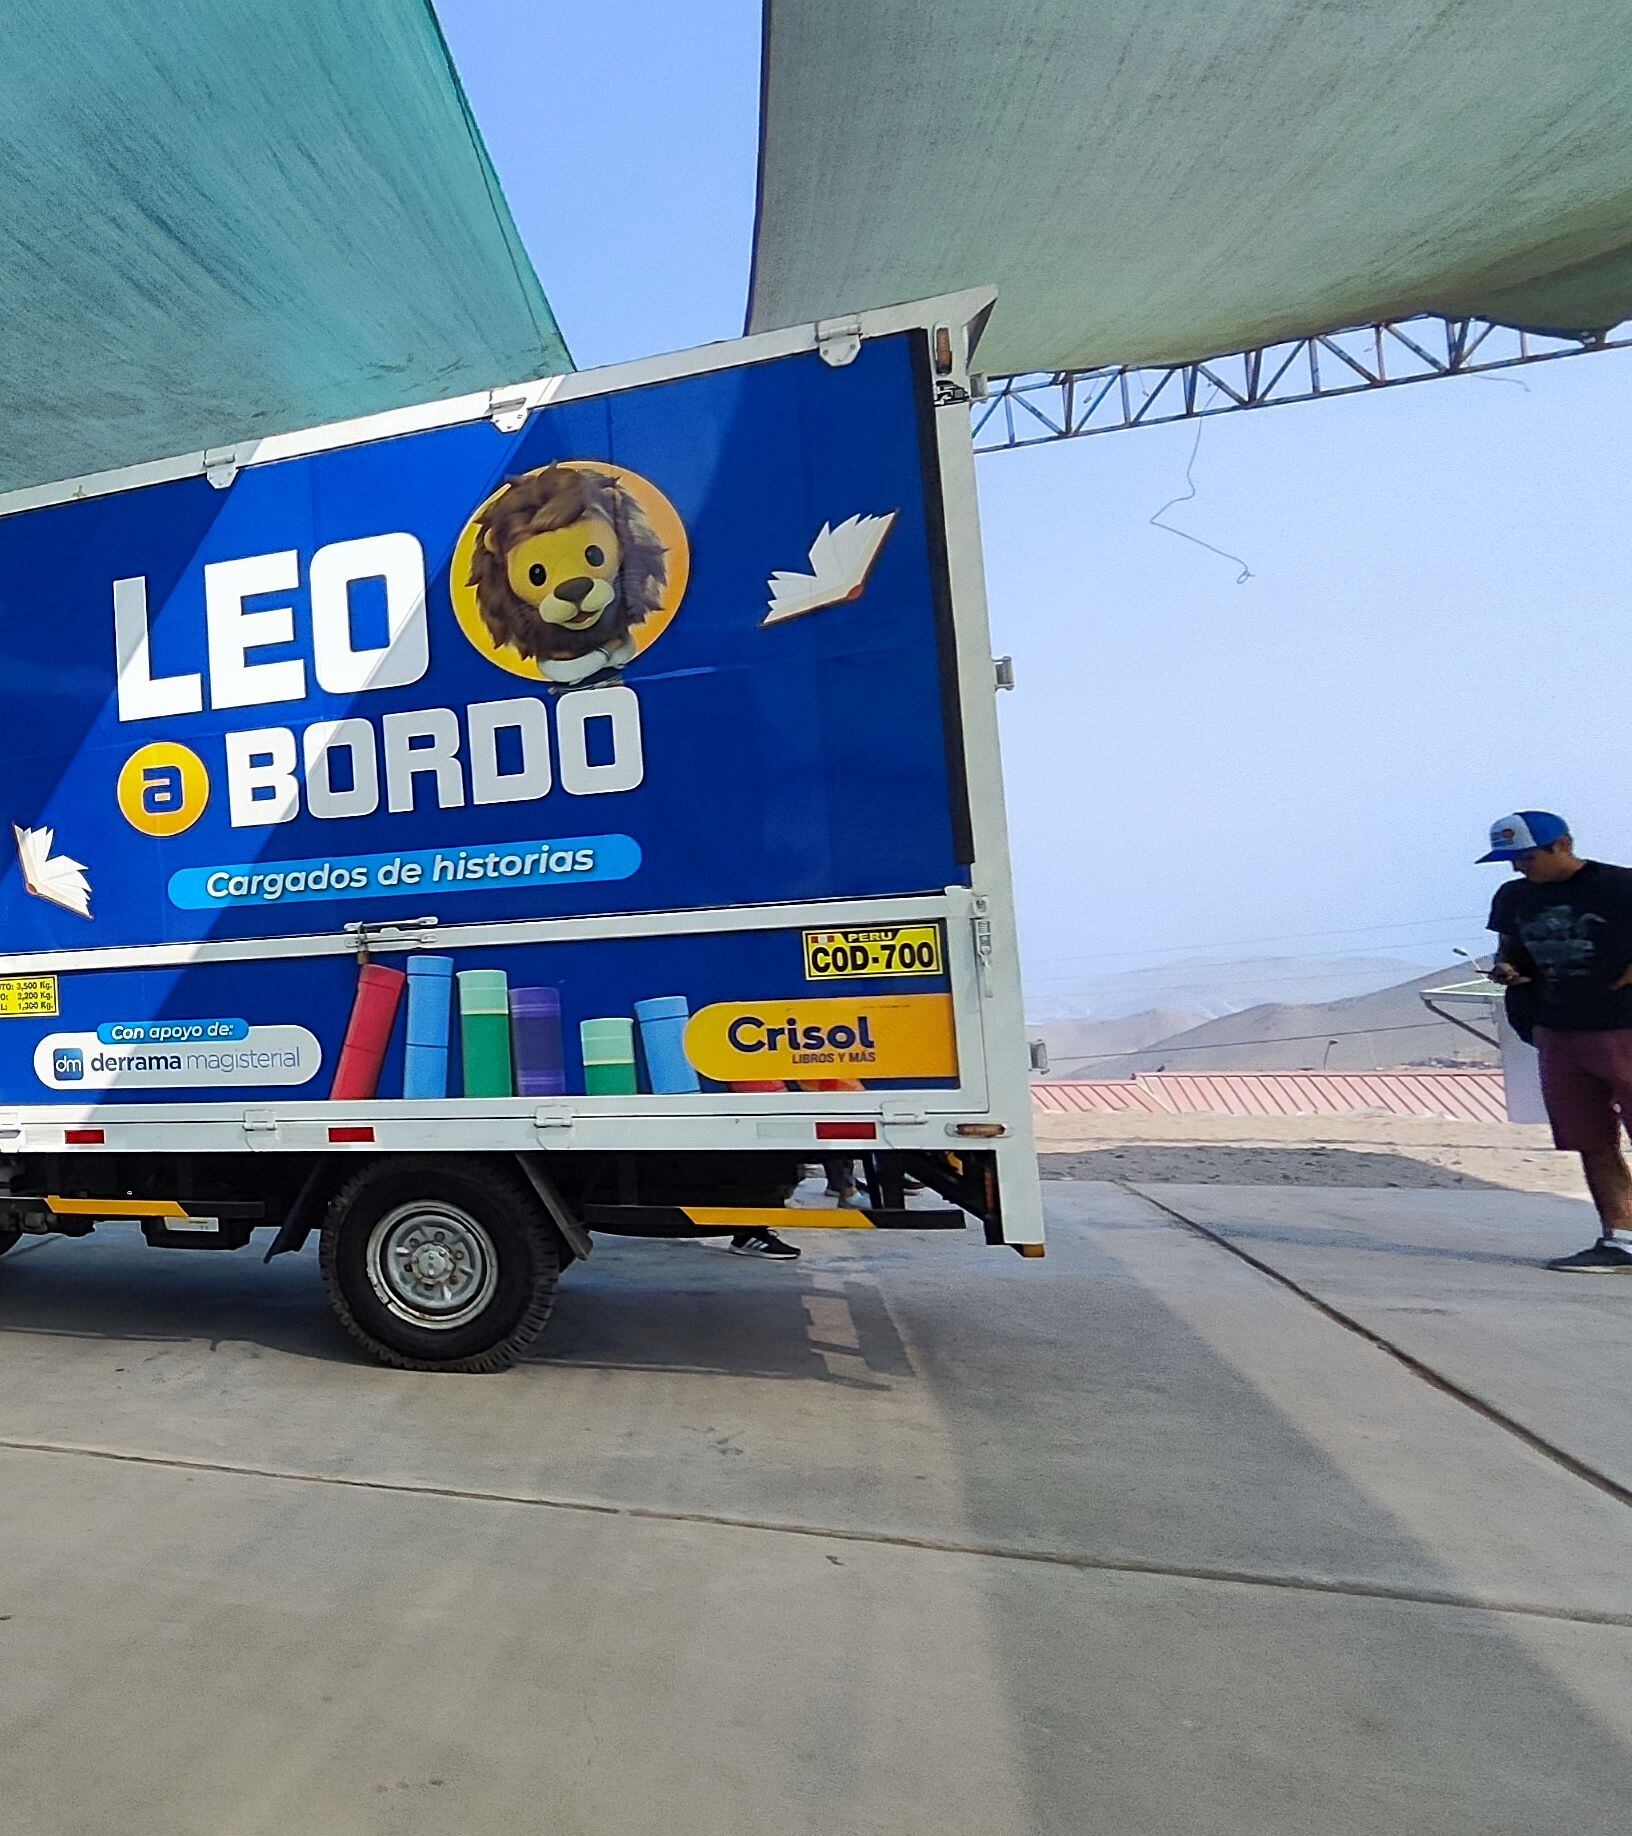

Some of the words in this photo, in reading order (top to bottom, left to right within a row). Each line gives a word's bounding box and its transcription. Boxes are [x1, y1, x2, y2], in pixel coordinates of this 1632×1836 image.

[112, 531, 430, 722] LEO
[141, 764, 186, 814] a
[224, 685, 645, 828] BORDO
[206, 862, 368, 900] Cargados
[376, 857, 423, 887] de
[432, 844, 595, 882] historias
[847, 930, 894, 943] PERU
[811, 941, 935, 974] COD-700
[111, 1025, 145, 1040] Con
[148, 1024, 204, 1042] apoyo
[206, 1021, 235, 1037] de:
[727, 1015, 876, 1053] Crisol
[55, 1055, 82, 1073] dm
[90, 1052, 182, 1073] derrama
[186, 1046, 301, 1074] magisterial
[791, 1052, 835, 1065] LIBROS
[838, 1052, 848, 1064] Y
[849, 1050, 877, 1063] MÁS
